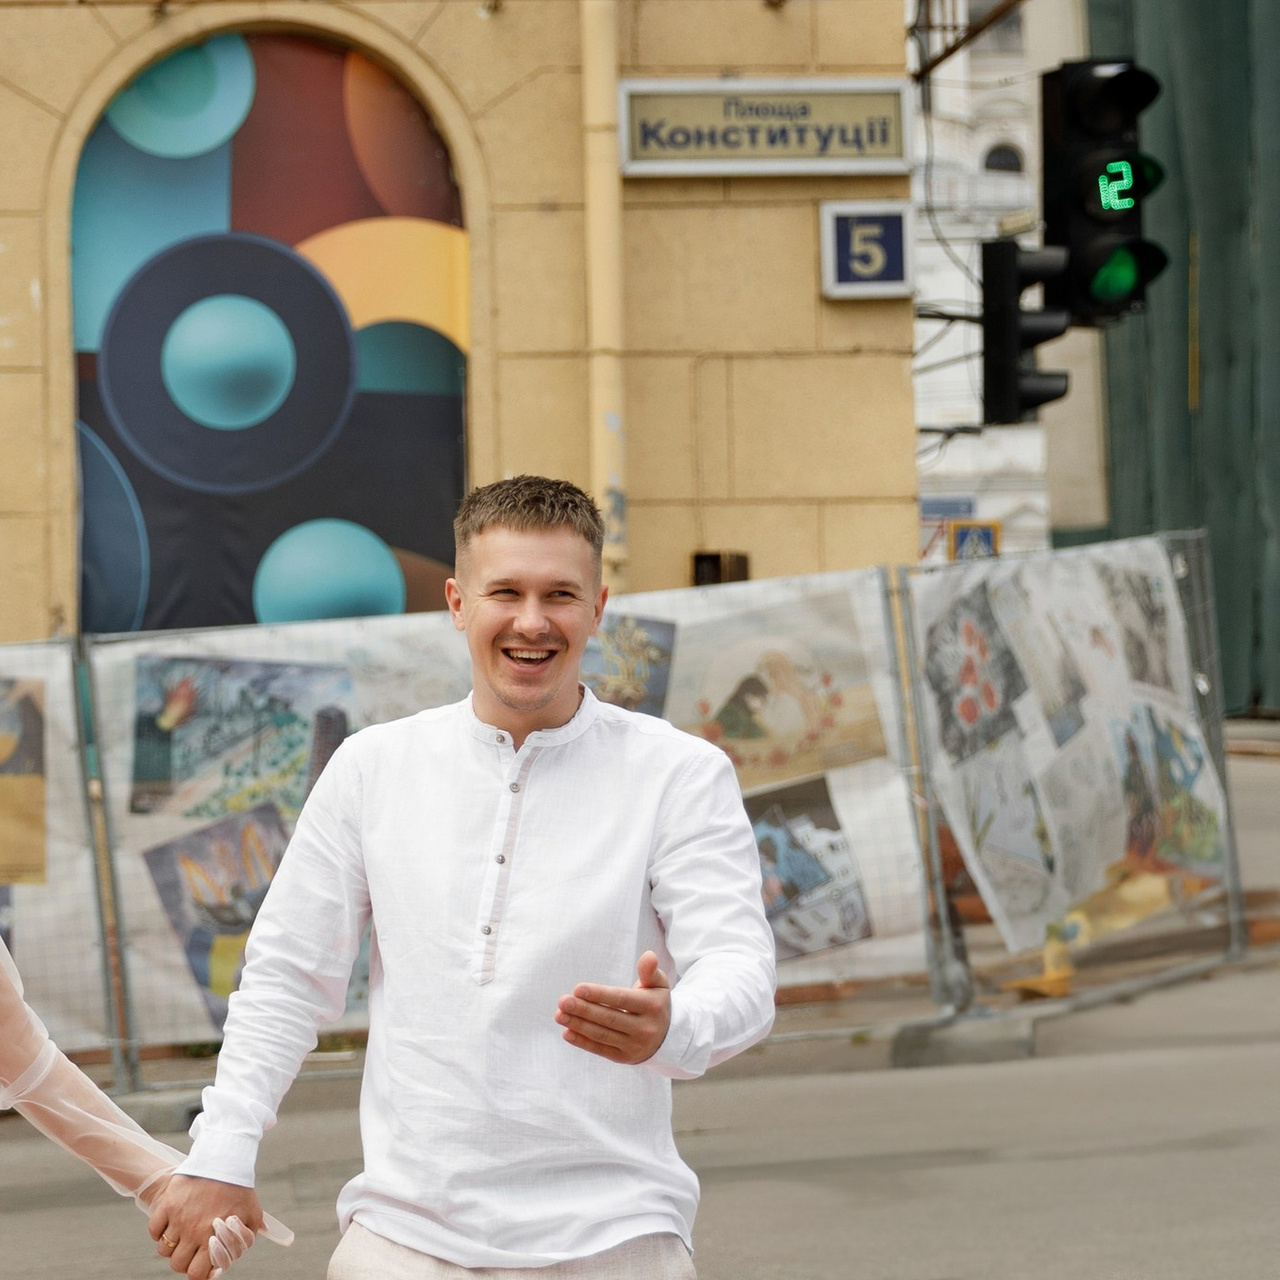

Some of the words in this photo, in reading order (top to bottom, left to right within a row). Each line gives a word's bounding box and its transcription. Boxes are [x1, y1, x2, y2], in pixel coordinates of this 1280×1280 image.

[723, 97, 811, 121] Площа
[639, 117, 890, 153] Конституції
[1098, 161, 1134, 210] 12
[846, 222, 887, 278] 5
